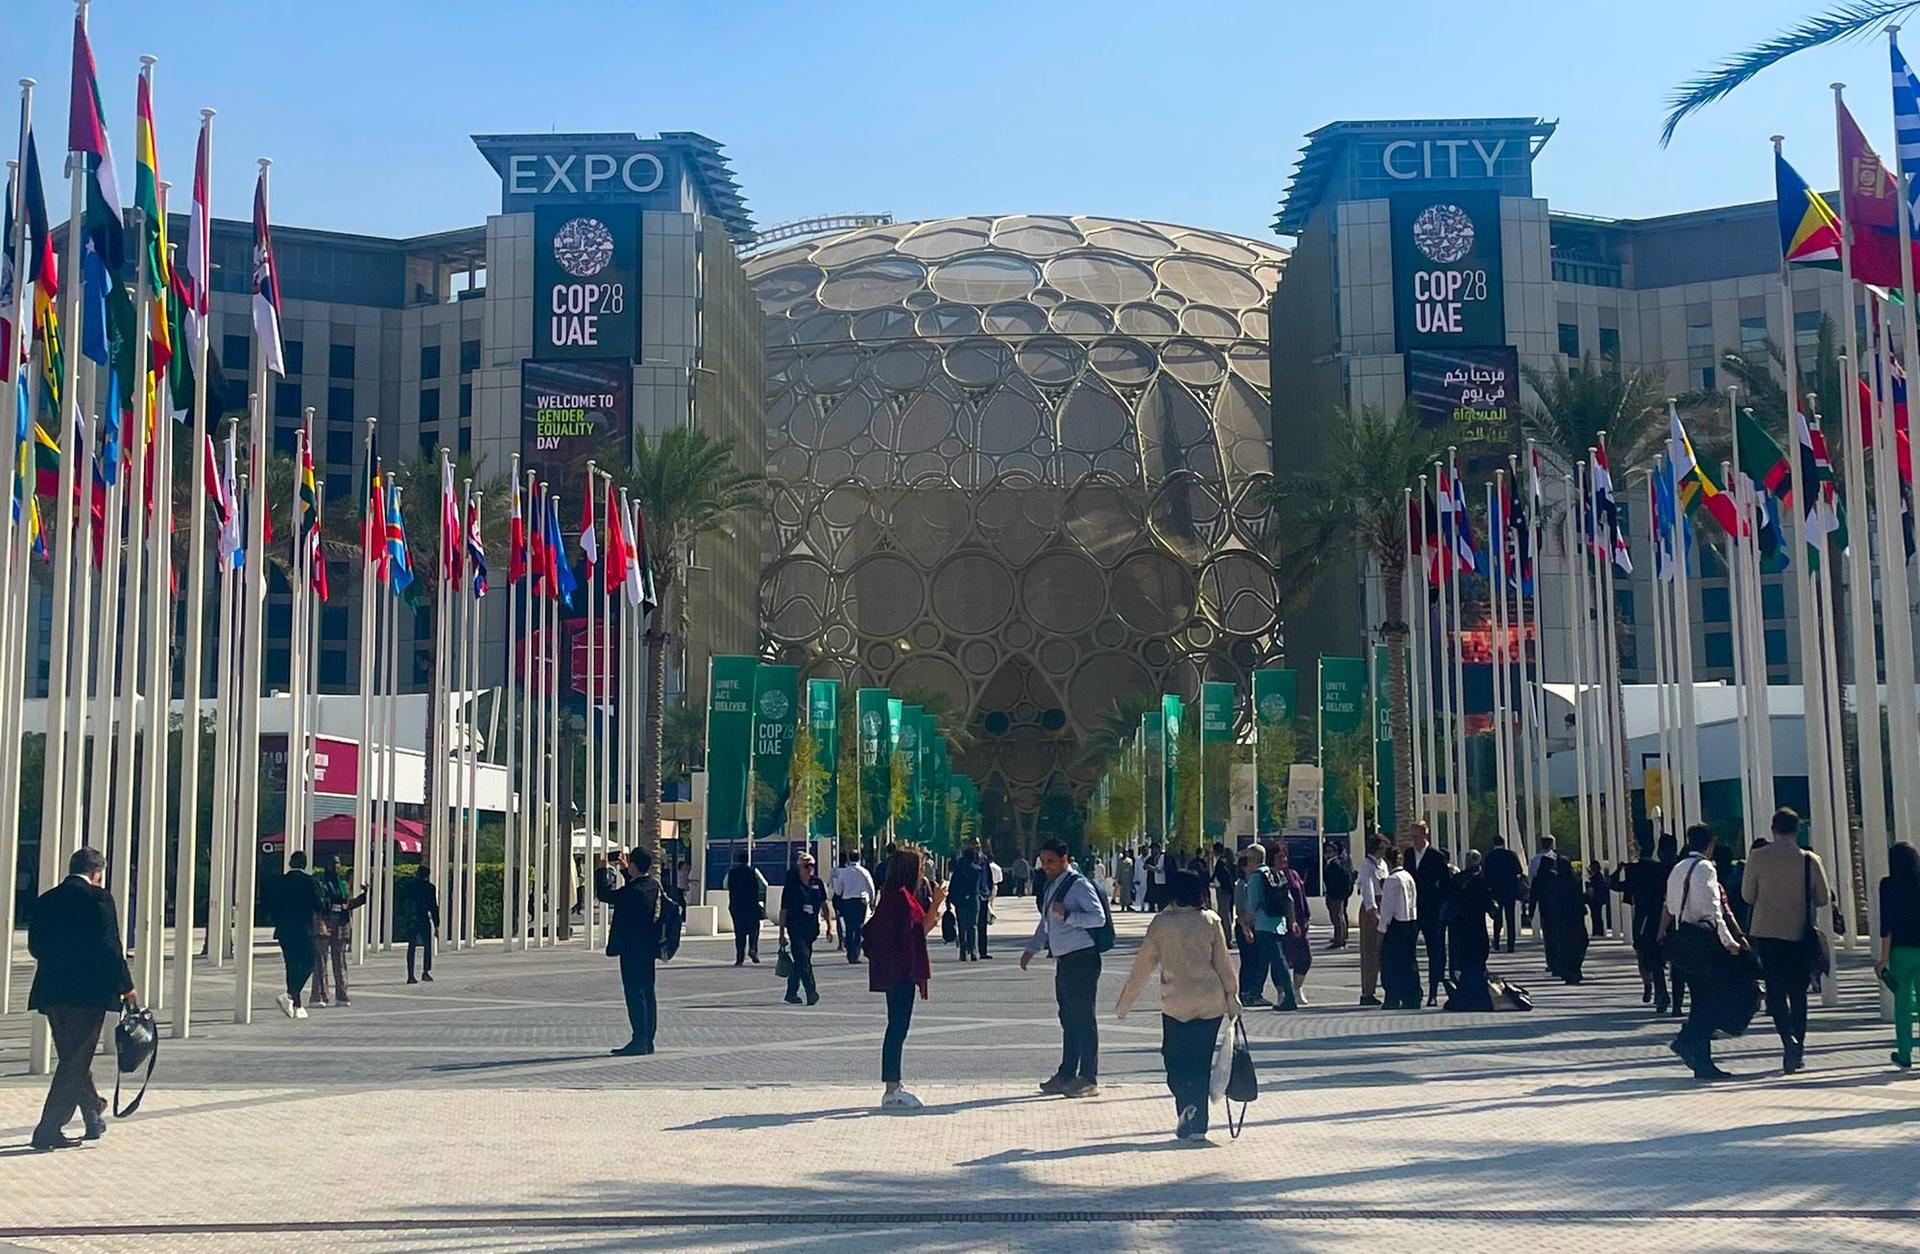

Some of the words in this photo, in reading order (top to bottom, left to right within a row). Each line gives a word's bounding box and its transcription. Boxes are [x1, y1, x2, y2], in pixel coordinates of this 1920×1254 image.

[1382, 138, 1506, 180] CITY
[509, 152, 664, 194] EXPO
[1414, 270, 1487, 301] COP28
[552, 283, 623, 314] COP28
[1415, 302, 1463, 333] UAE
[551, 315, 598, 346] UAE
[1444, 368, 1468, 387] بكم
[537, 394, 597, 409] WELCOME
[598, 394, 614, 408] TO
[1461, 388, 1484, 404] يوم
[1485, 385, 1505, 406] في
[537, 409, 585, 423] GENDER
[537, 422, 594, 437] EQUALITY
[537, 436, 560, 450] DAY
[759, 739, 782, 755] UAE
